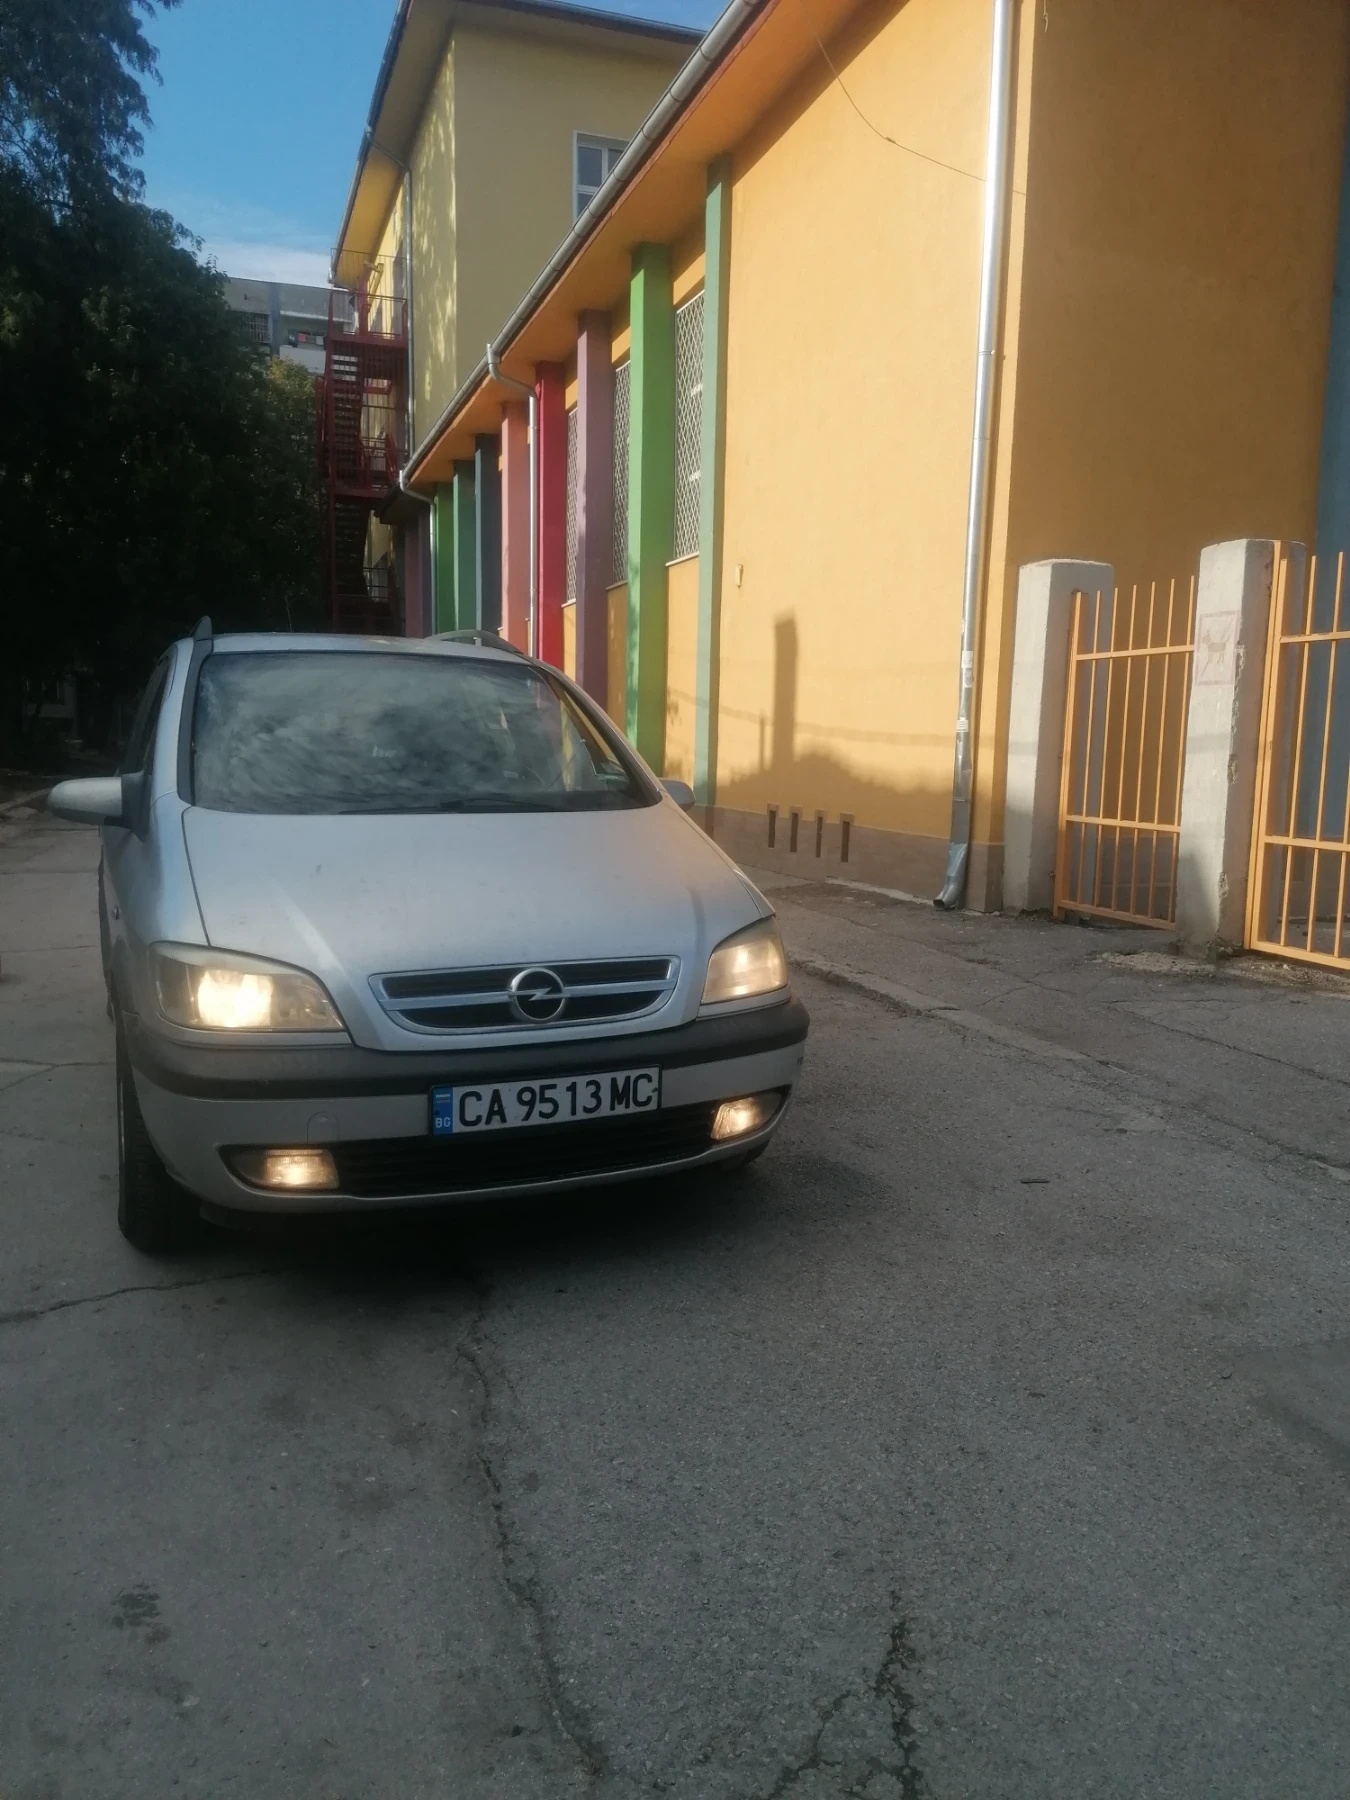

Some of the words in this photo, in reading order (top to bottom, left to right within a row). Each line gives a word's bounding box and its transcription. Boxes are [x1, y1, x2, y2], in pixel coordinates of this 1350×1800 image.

[459, 1089, 507, 1127] CA
[516, 1080, 602, 1121] 9513
[609, 1073, 653, 1111] MC
[435, 1117, 451, 1128] BG
